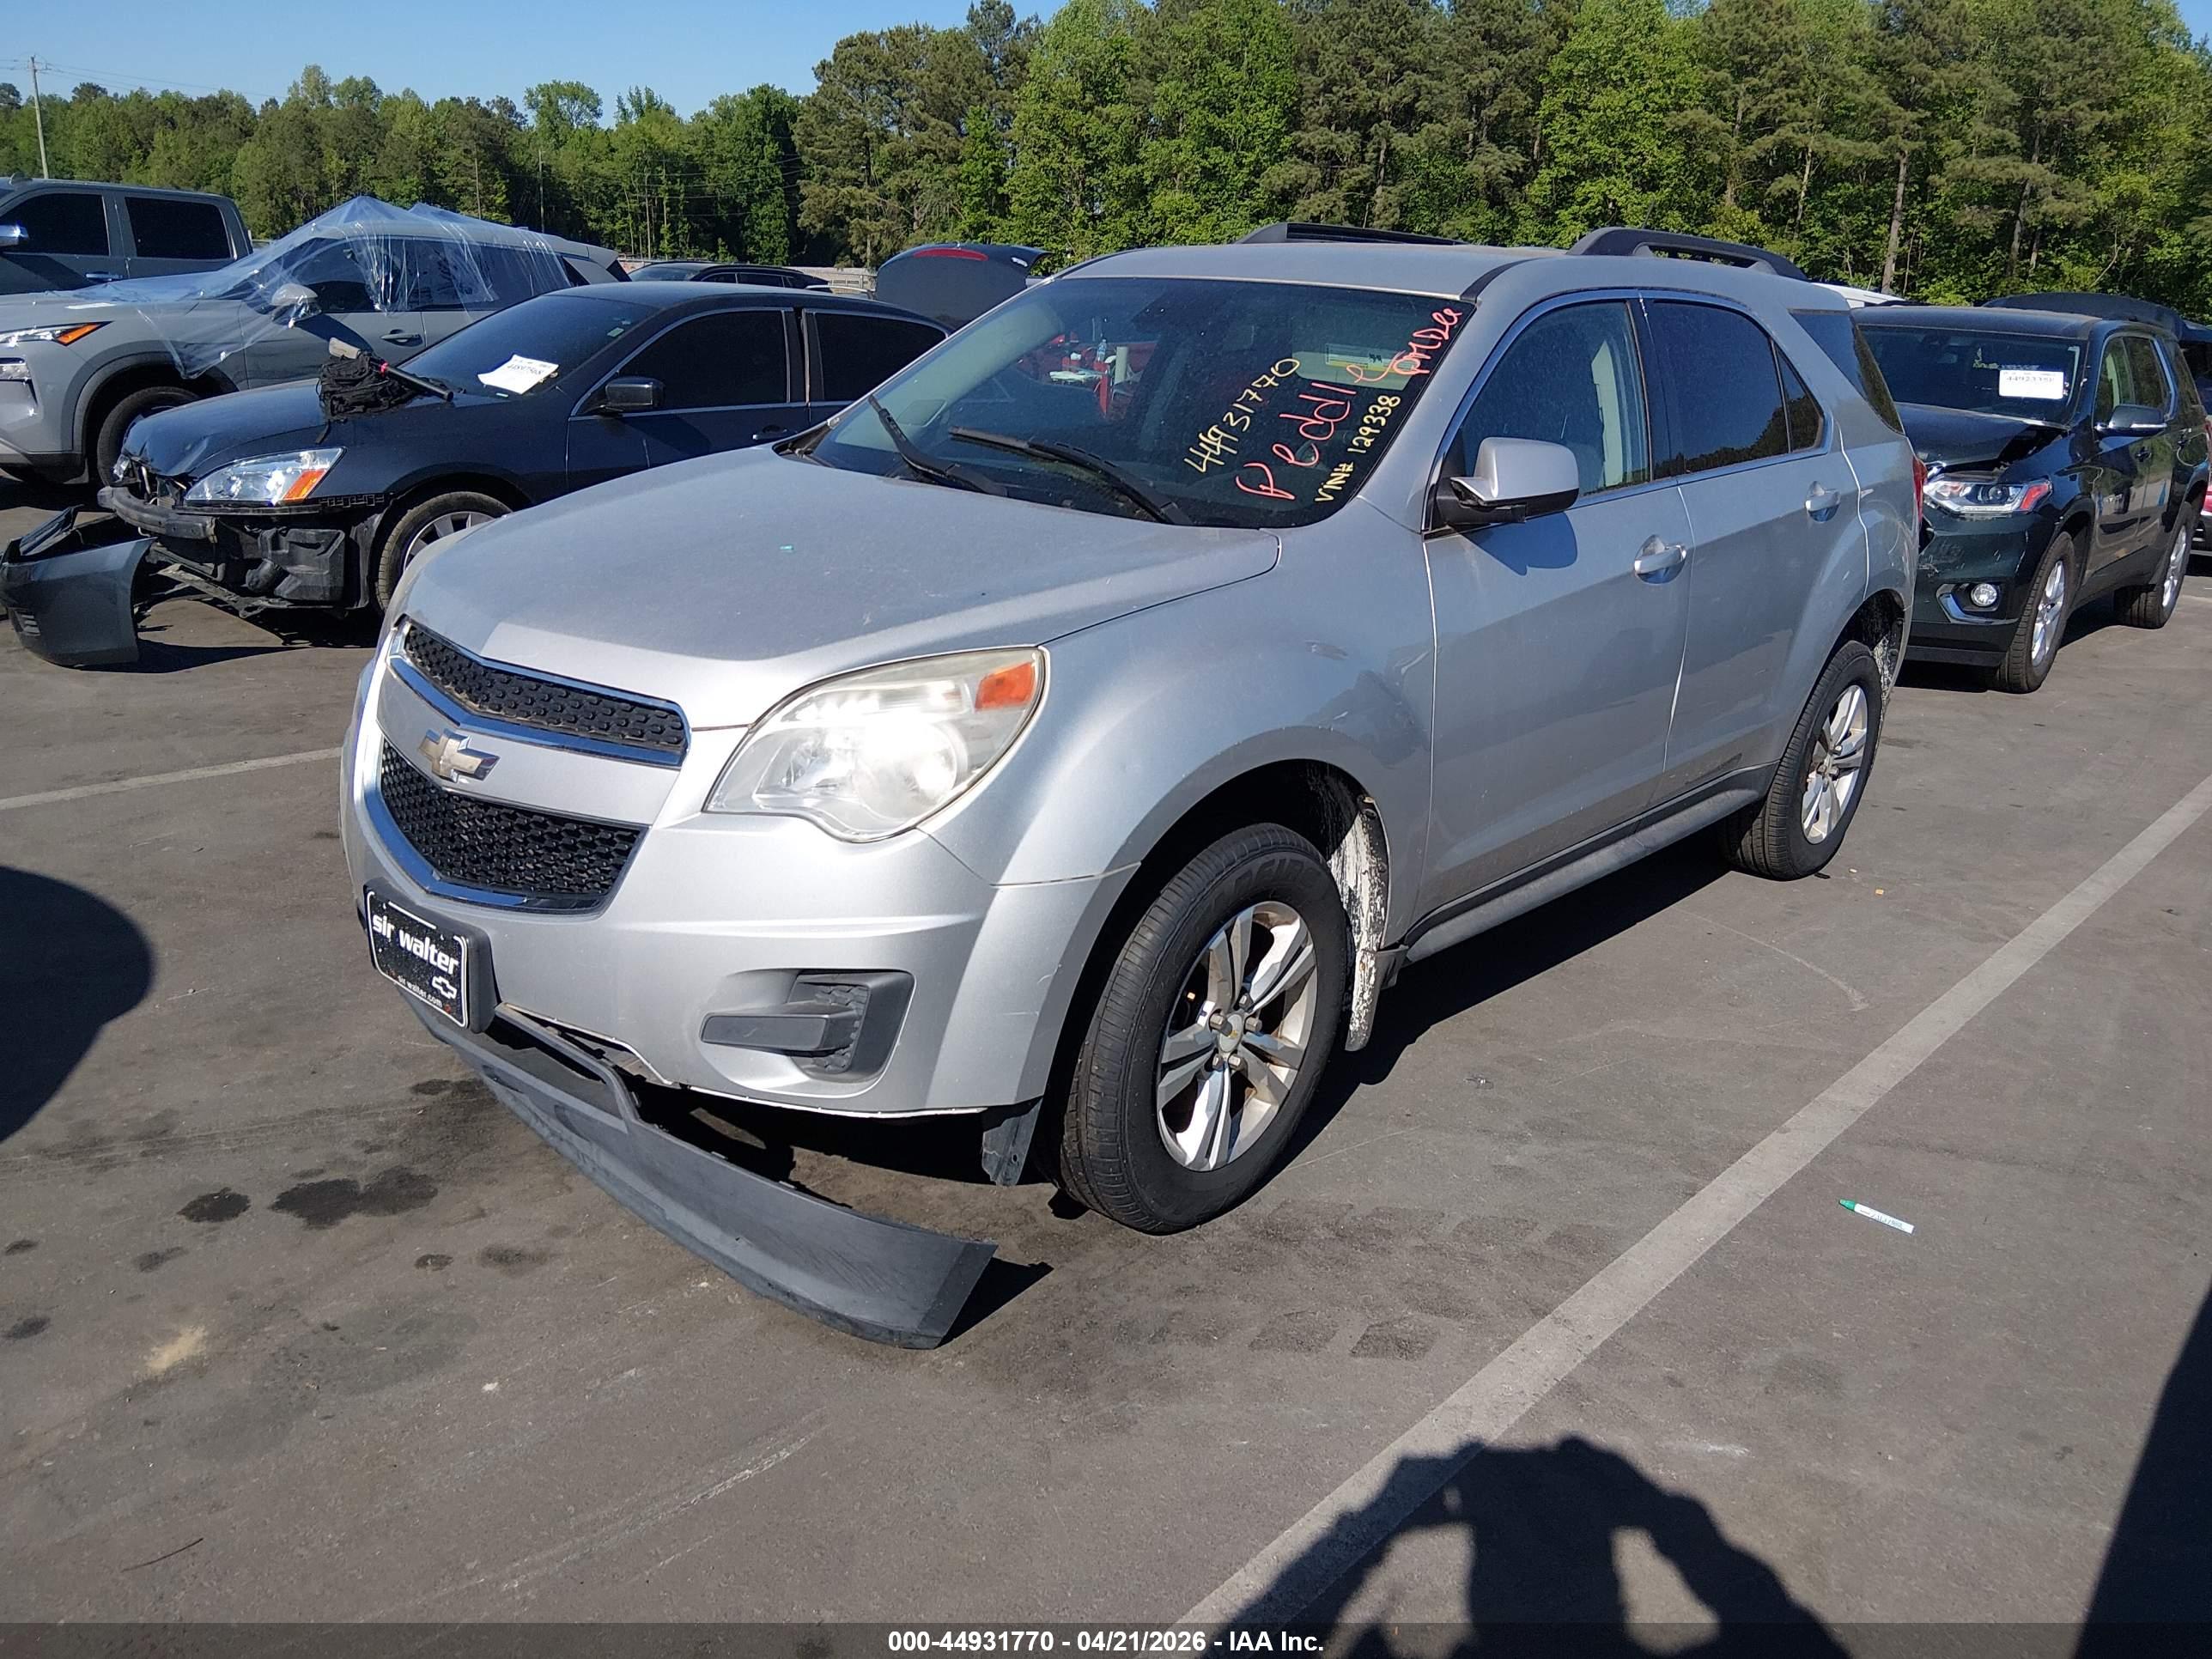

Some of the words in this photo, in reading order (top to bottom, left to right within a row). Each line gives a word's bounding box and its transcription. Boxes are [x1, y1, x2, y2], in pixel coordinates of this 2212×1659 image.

[1183, 357, 1301, 474] 44931770
[1346, 393, 1402, 454] 129338
[372, 914, 396, 939] sir
[398, 929, 459, 975] walter
